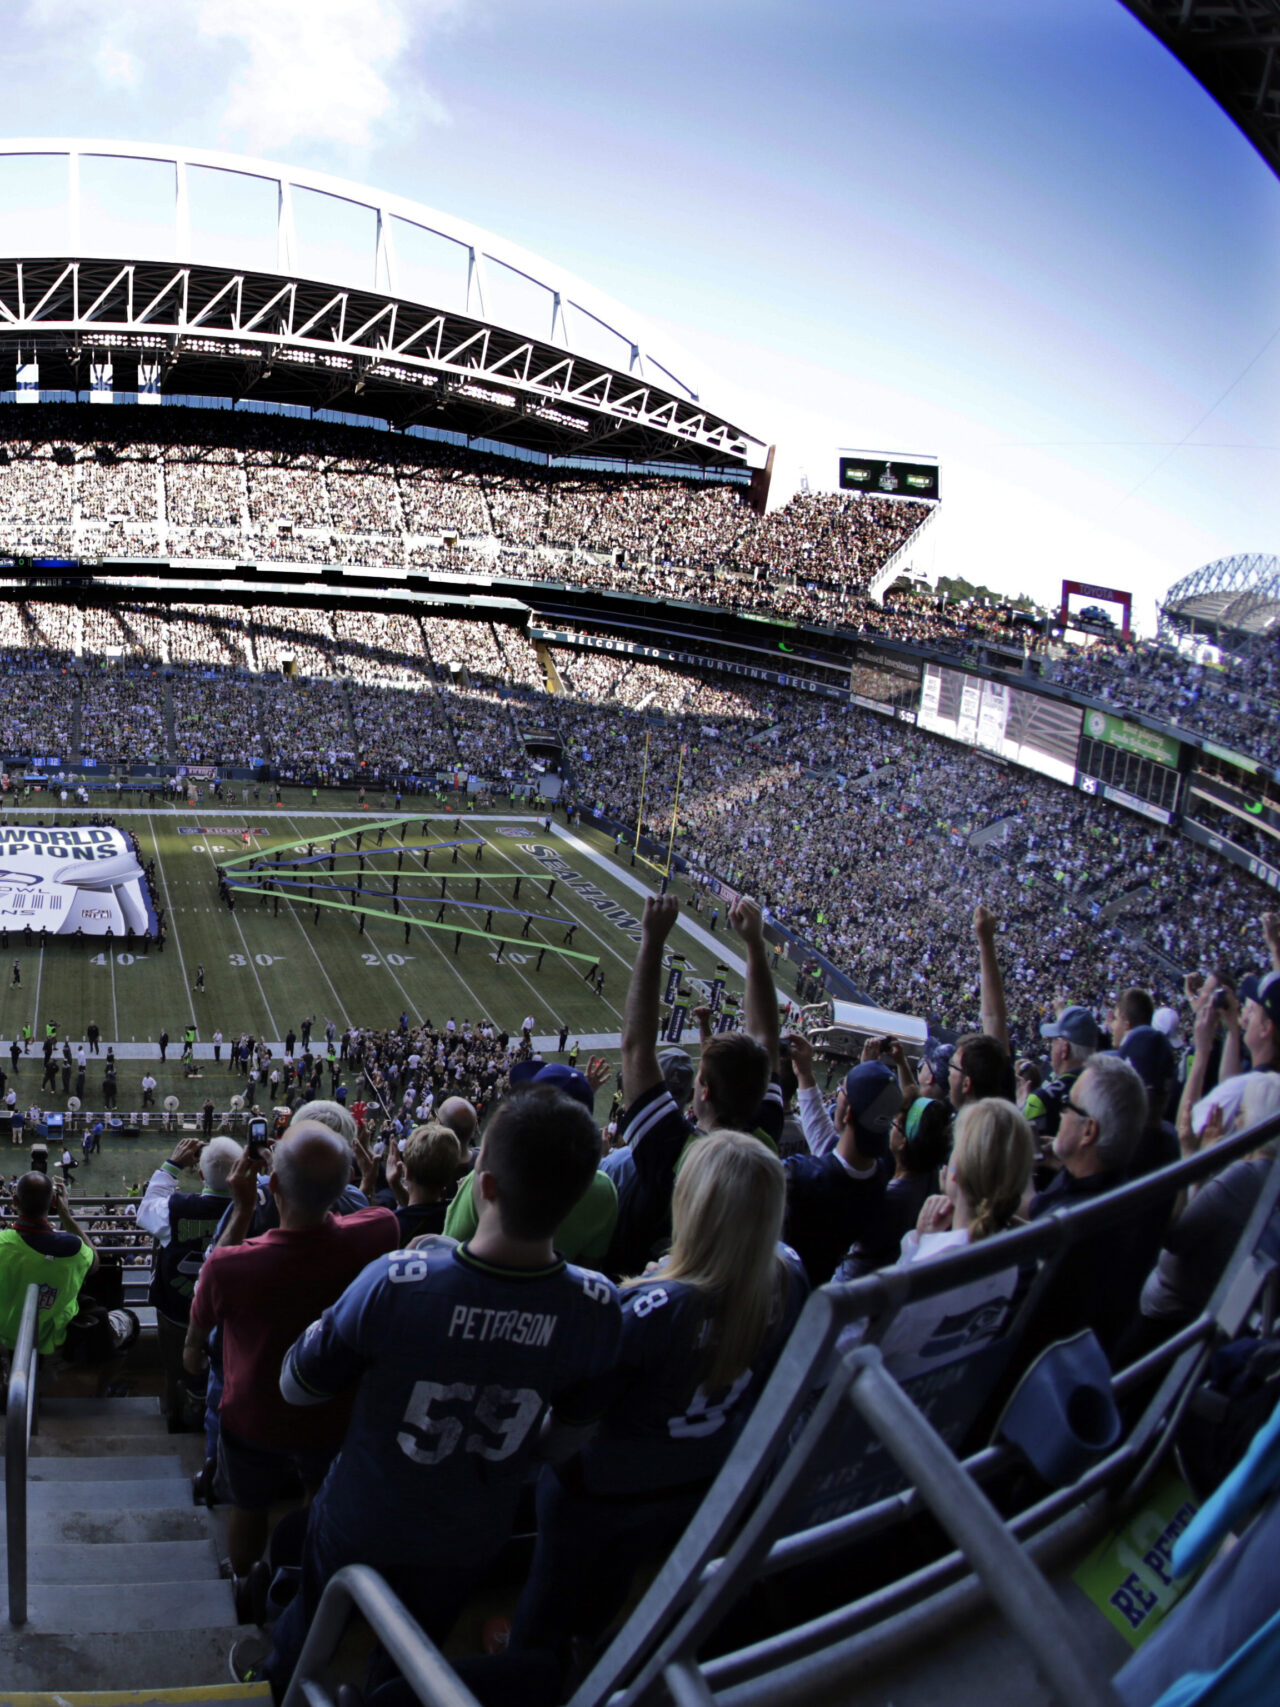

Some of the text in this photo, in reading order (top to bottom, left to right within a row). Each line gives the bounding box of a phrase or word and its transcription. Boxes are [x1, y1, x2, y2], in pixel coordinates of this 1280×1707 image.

[1080, 585, 1114, 600] TOYOTA
[566, 633, 634, 653] WELCOME
[644, 647, 660, 657] TO
[668, 652, 768, 680] CENTURYLINK
[516, 843, 698, 972] SEAHAWS
[90, 953, 135, 966] 40
[228, 953, 273, 967] 30
[361, 953, 406, 966] 20
[448, 1305, 558, 1347] PETERSON
[397, 1381, 543, 1464] 59
[1110, 1573, 1160, 1629] RE
